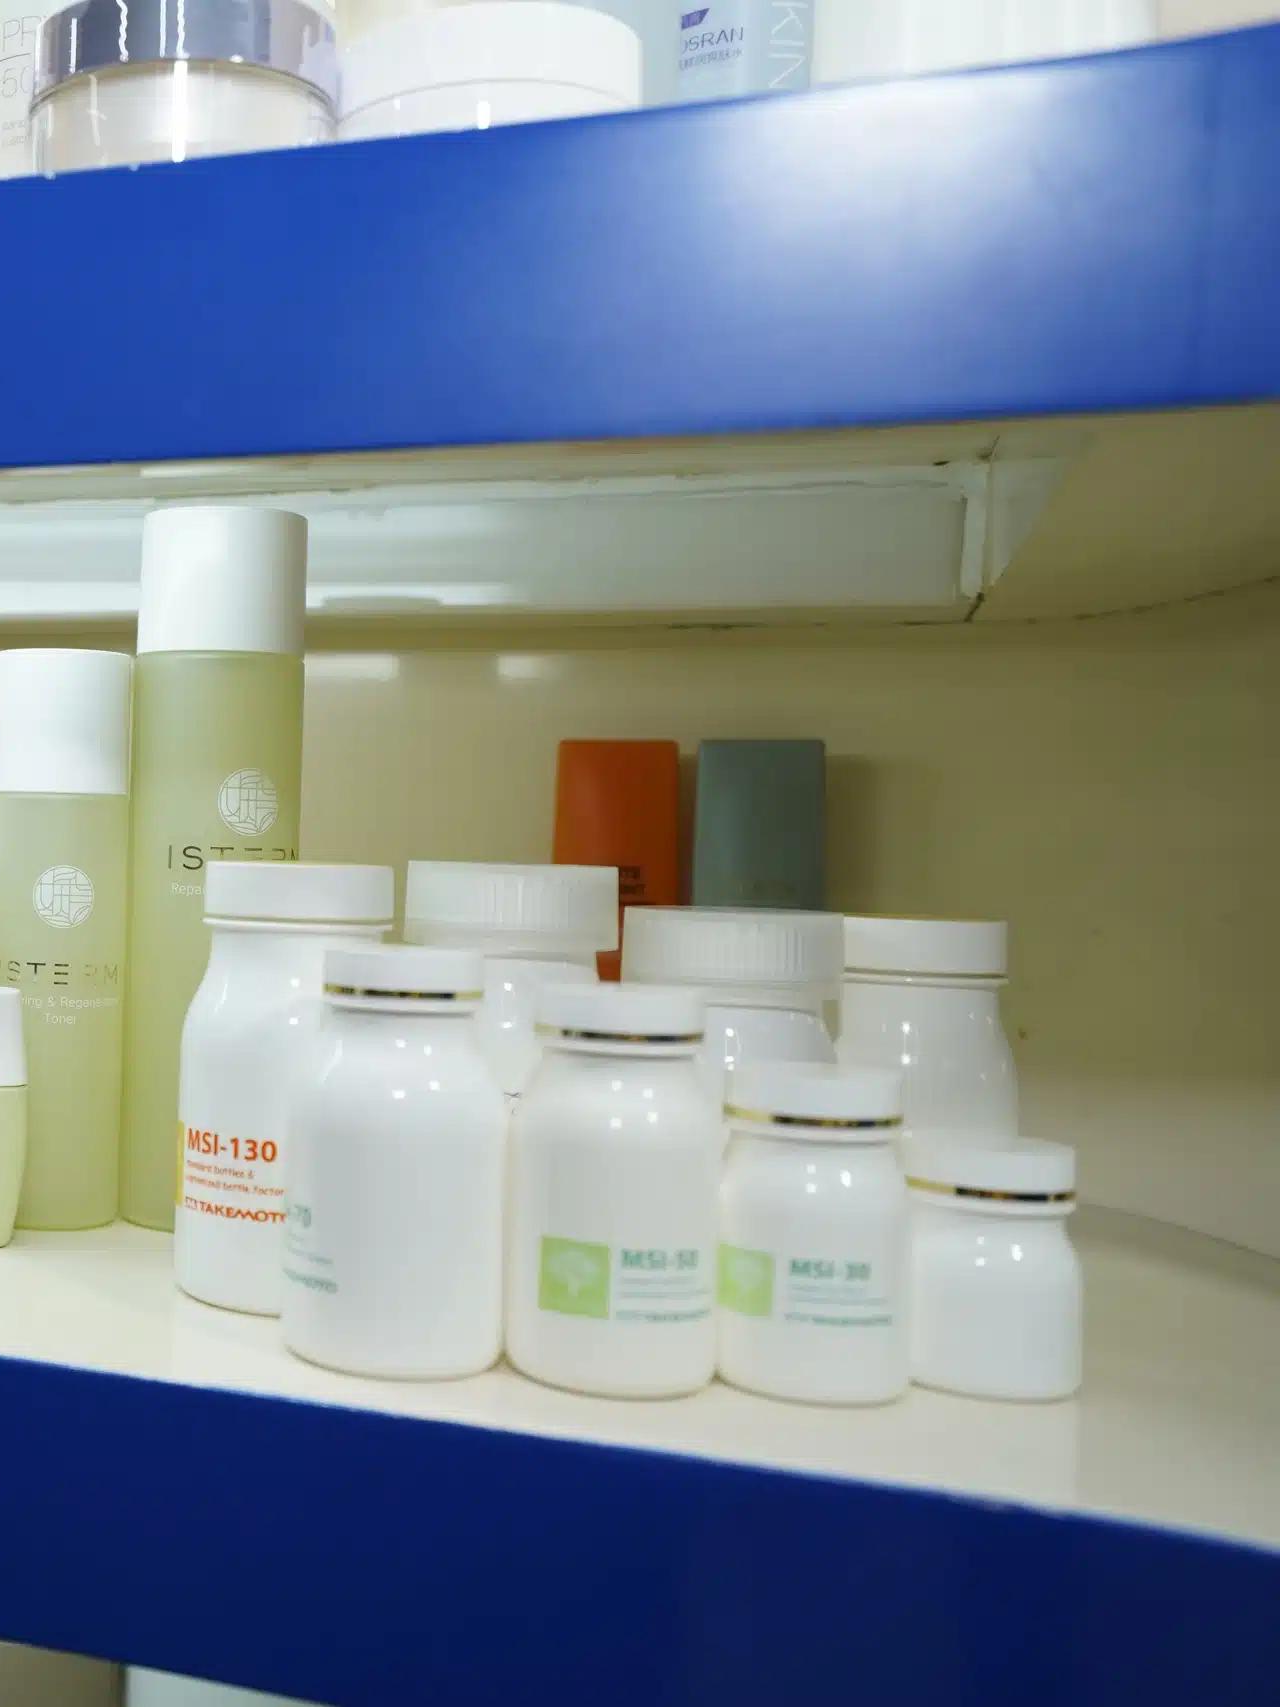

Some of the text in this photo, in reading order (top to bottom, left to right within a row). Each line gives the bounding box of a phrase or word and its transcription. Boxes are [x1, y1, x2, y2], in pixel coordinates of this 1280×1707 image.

[172, 883, 206, 897] Repa
[21, 996, 43, 1009] ring
[187, 1127, 278, 1163] MSI-130
